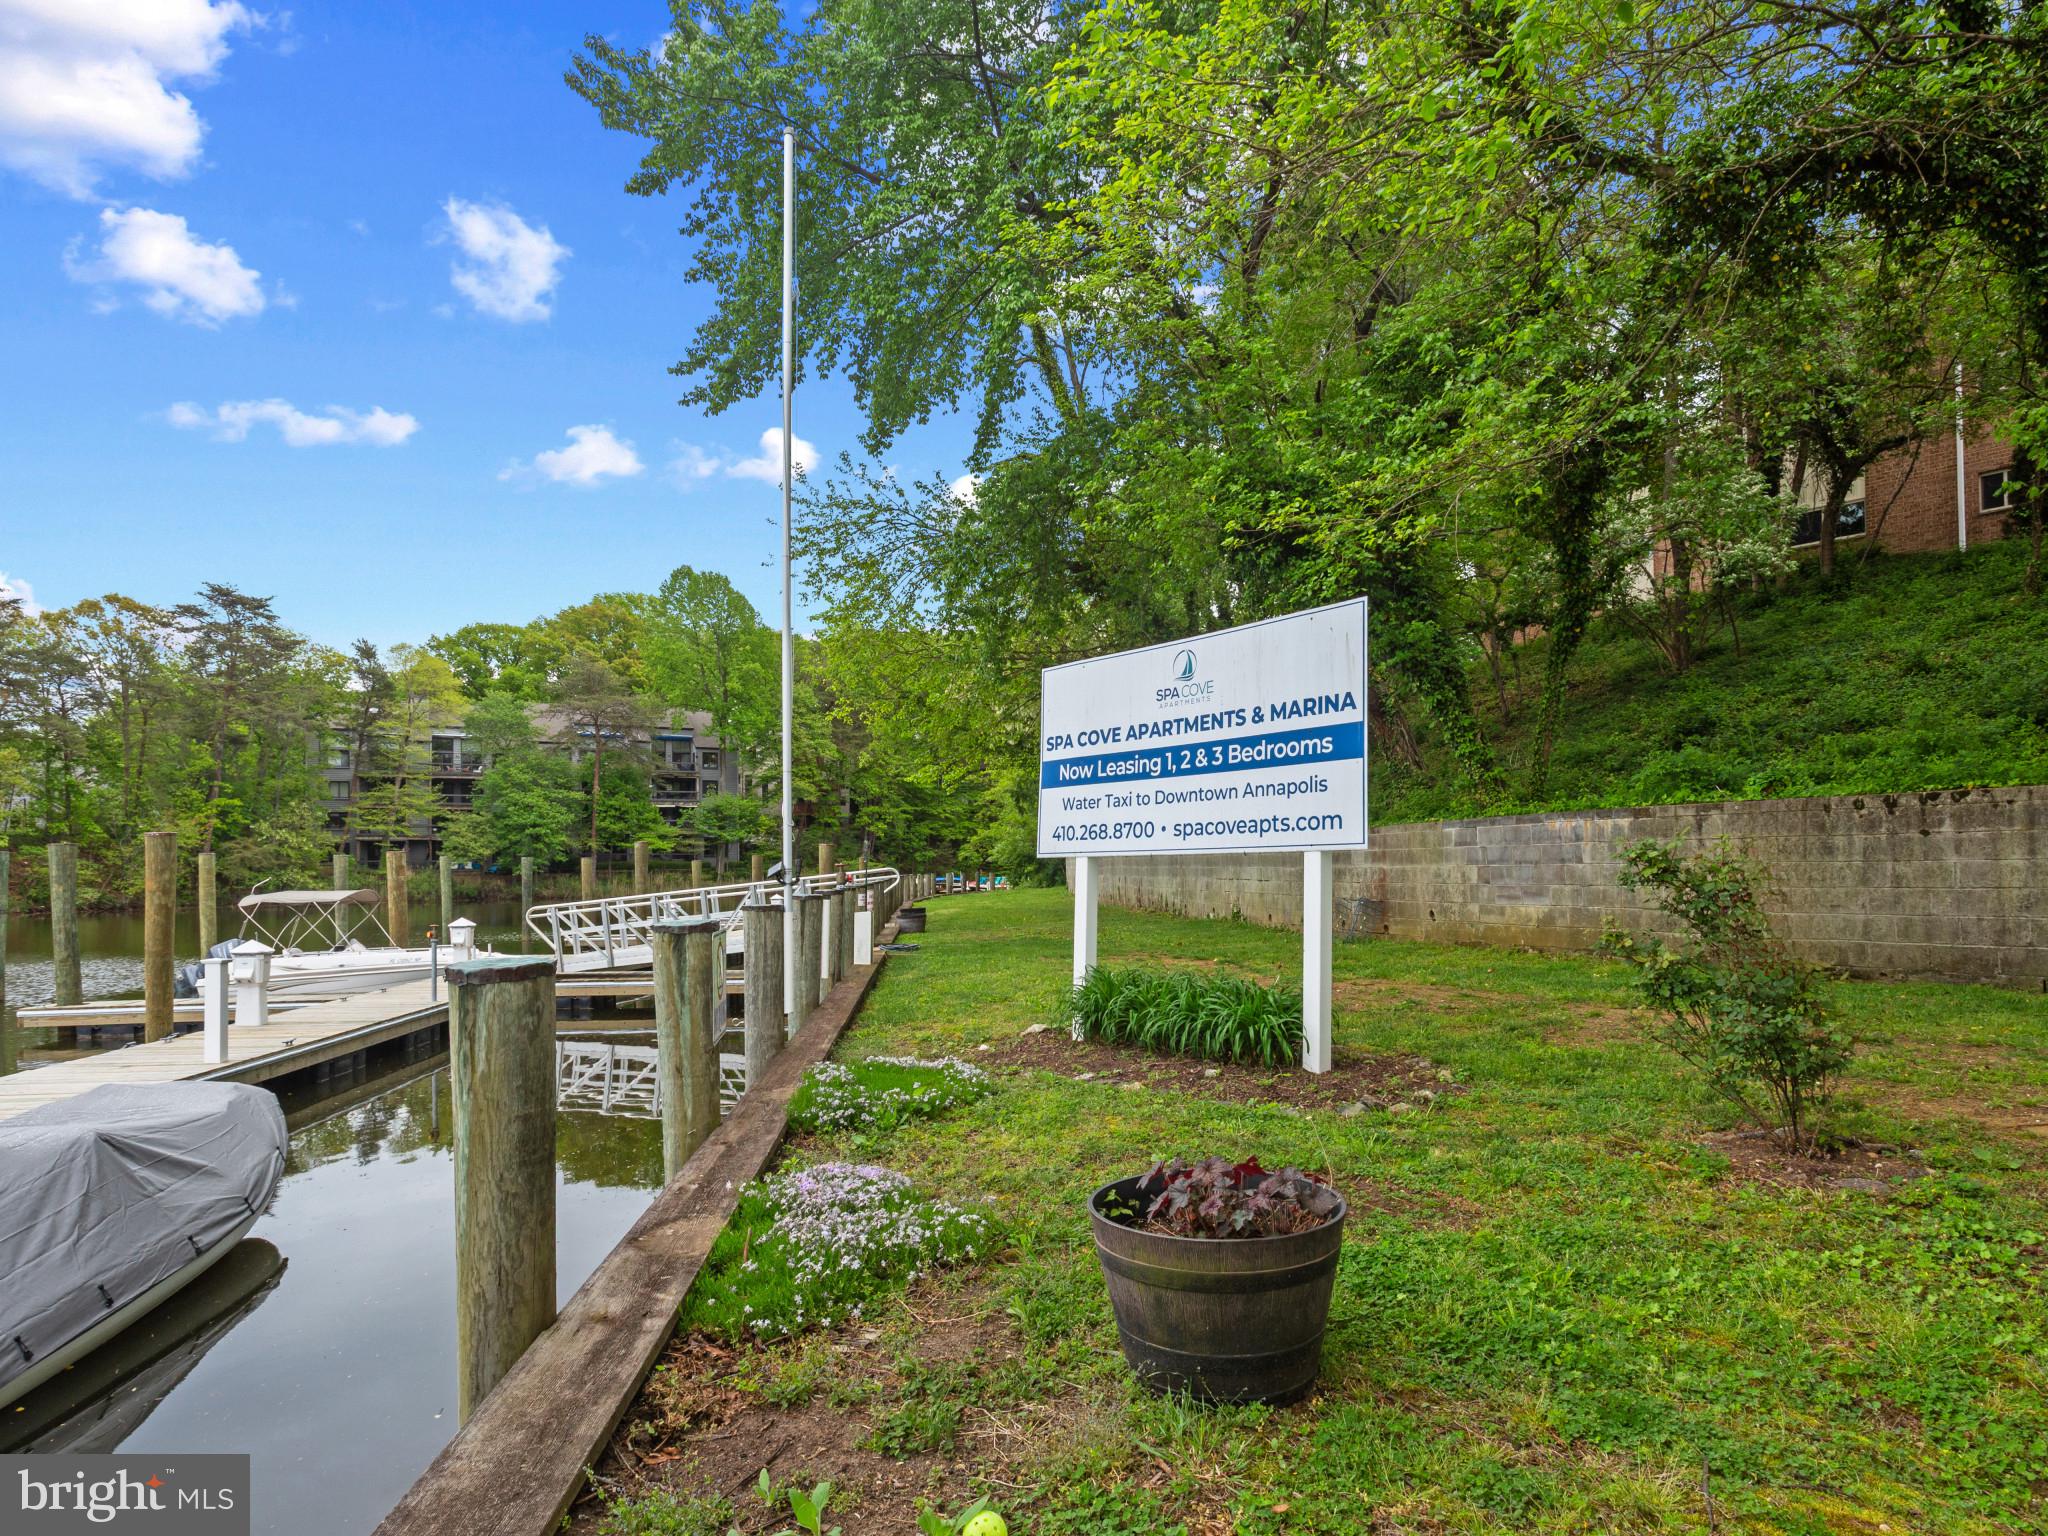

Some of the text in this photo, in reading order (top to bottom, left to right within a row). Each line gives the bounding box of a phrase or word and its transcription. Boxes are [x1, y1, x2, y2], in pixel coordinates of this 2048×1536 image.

[1156, 680, 1215, 702] SPA COVE
[1159, 695, 1212, 709] APARTMENTS
[1046, 691, 1357, 752] SPA COVE APARTMENTS & MARINA
[1059, 736, 1334, 781] Now Leasing 1, 2 & 3 Bedrooms
[1062, 774, 1329, 811] Water Taxi to Downtown Annapolis
[1052, 812, 1343, 842] 410.268.8700 spacoveapts.com
